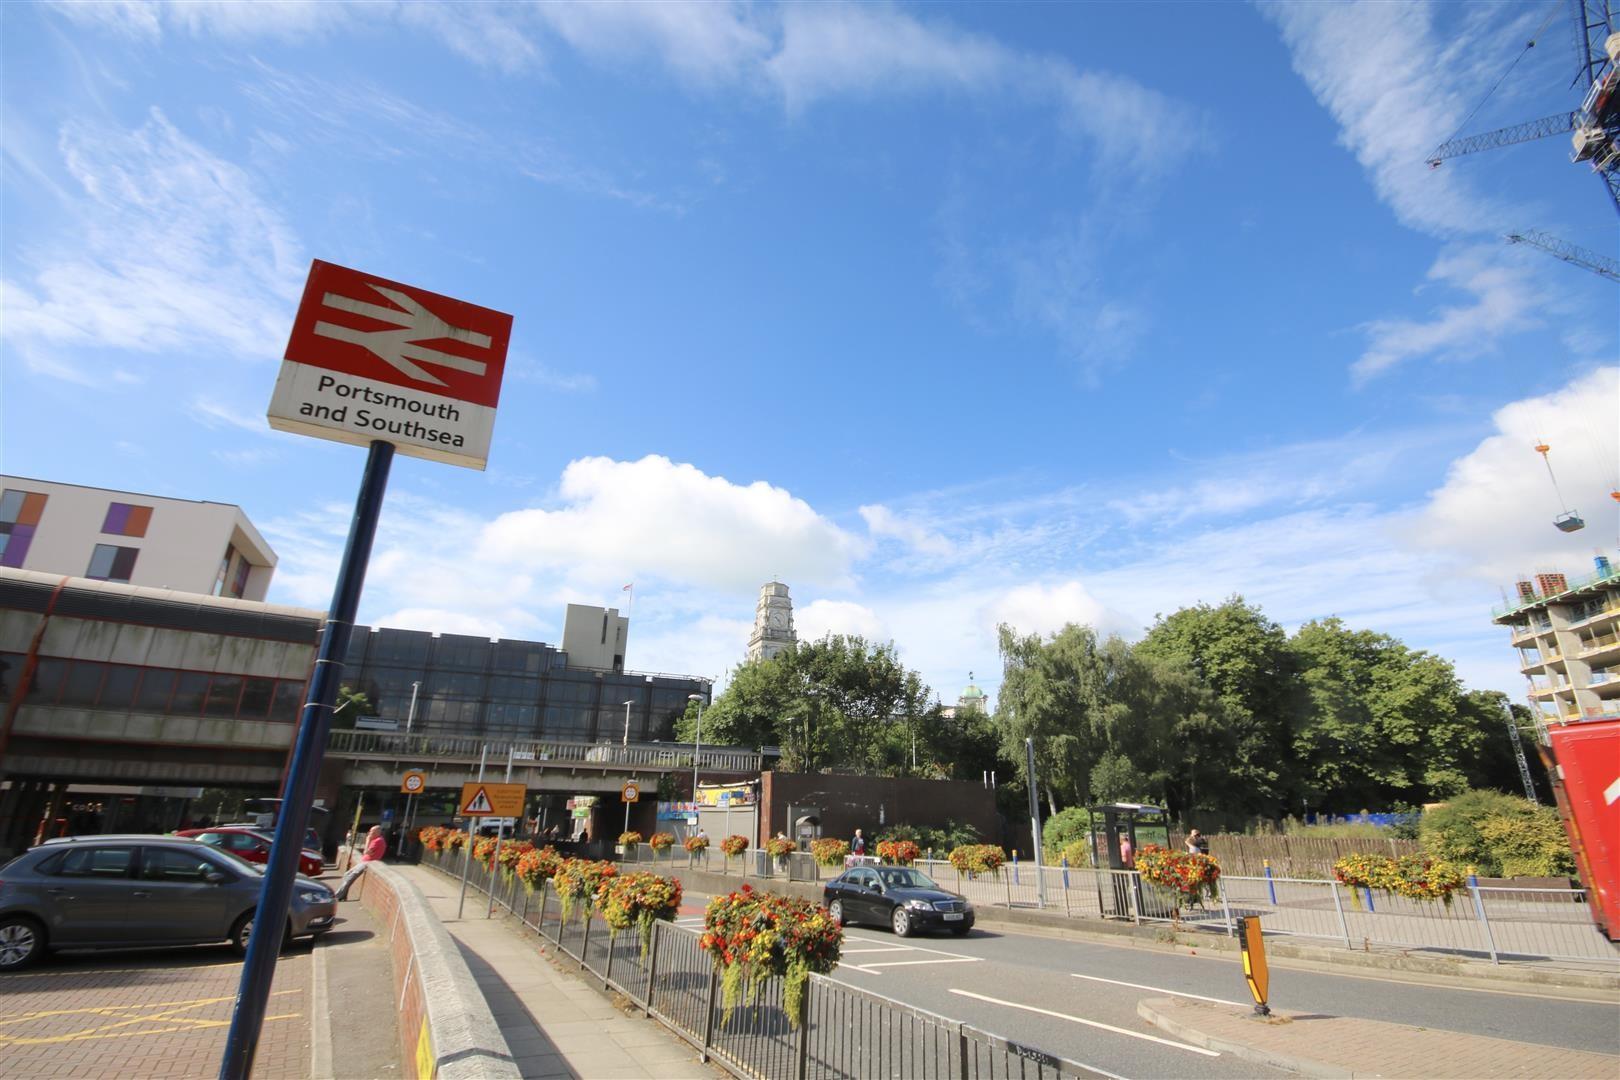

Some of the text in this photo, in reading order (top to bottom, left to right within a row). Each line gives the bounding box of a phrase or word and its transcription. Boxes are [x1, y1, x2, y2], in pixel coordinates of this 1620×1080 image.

[318, 375, 460, 422] Portsmouth
[299, 402, 465, 447] and Southsea
